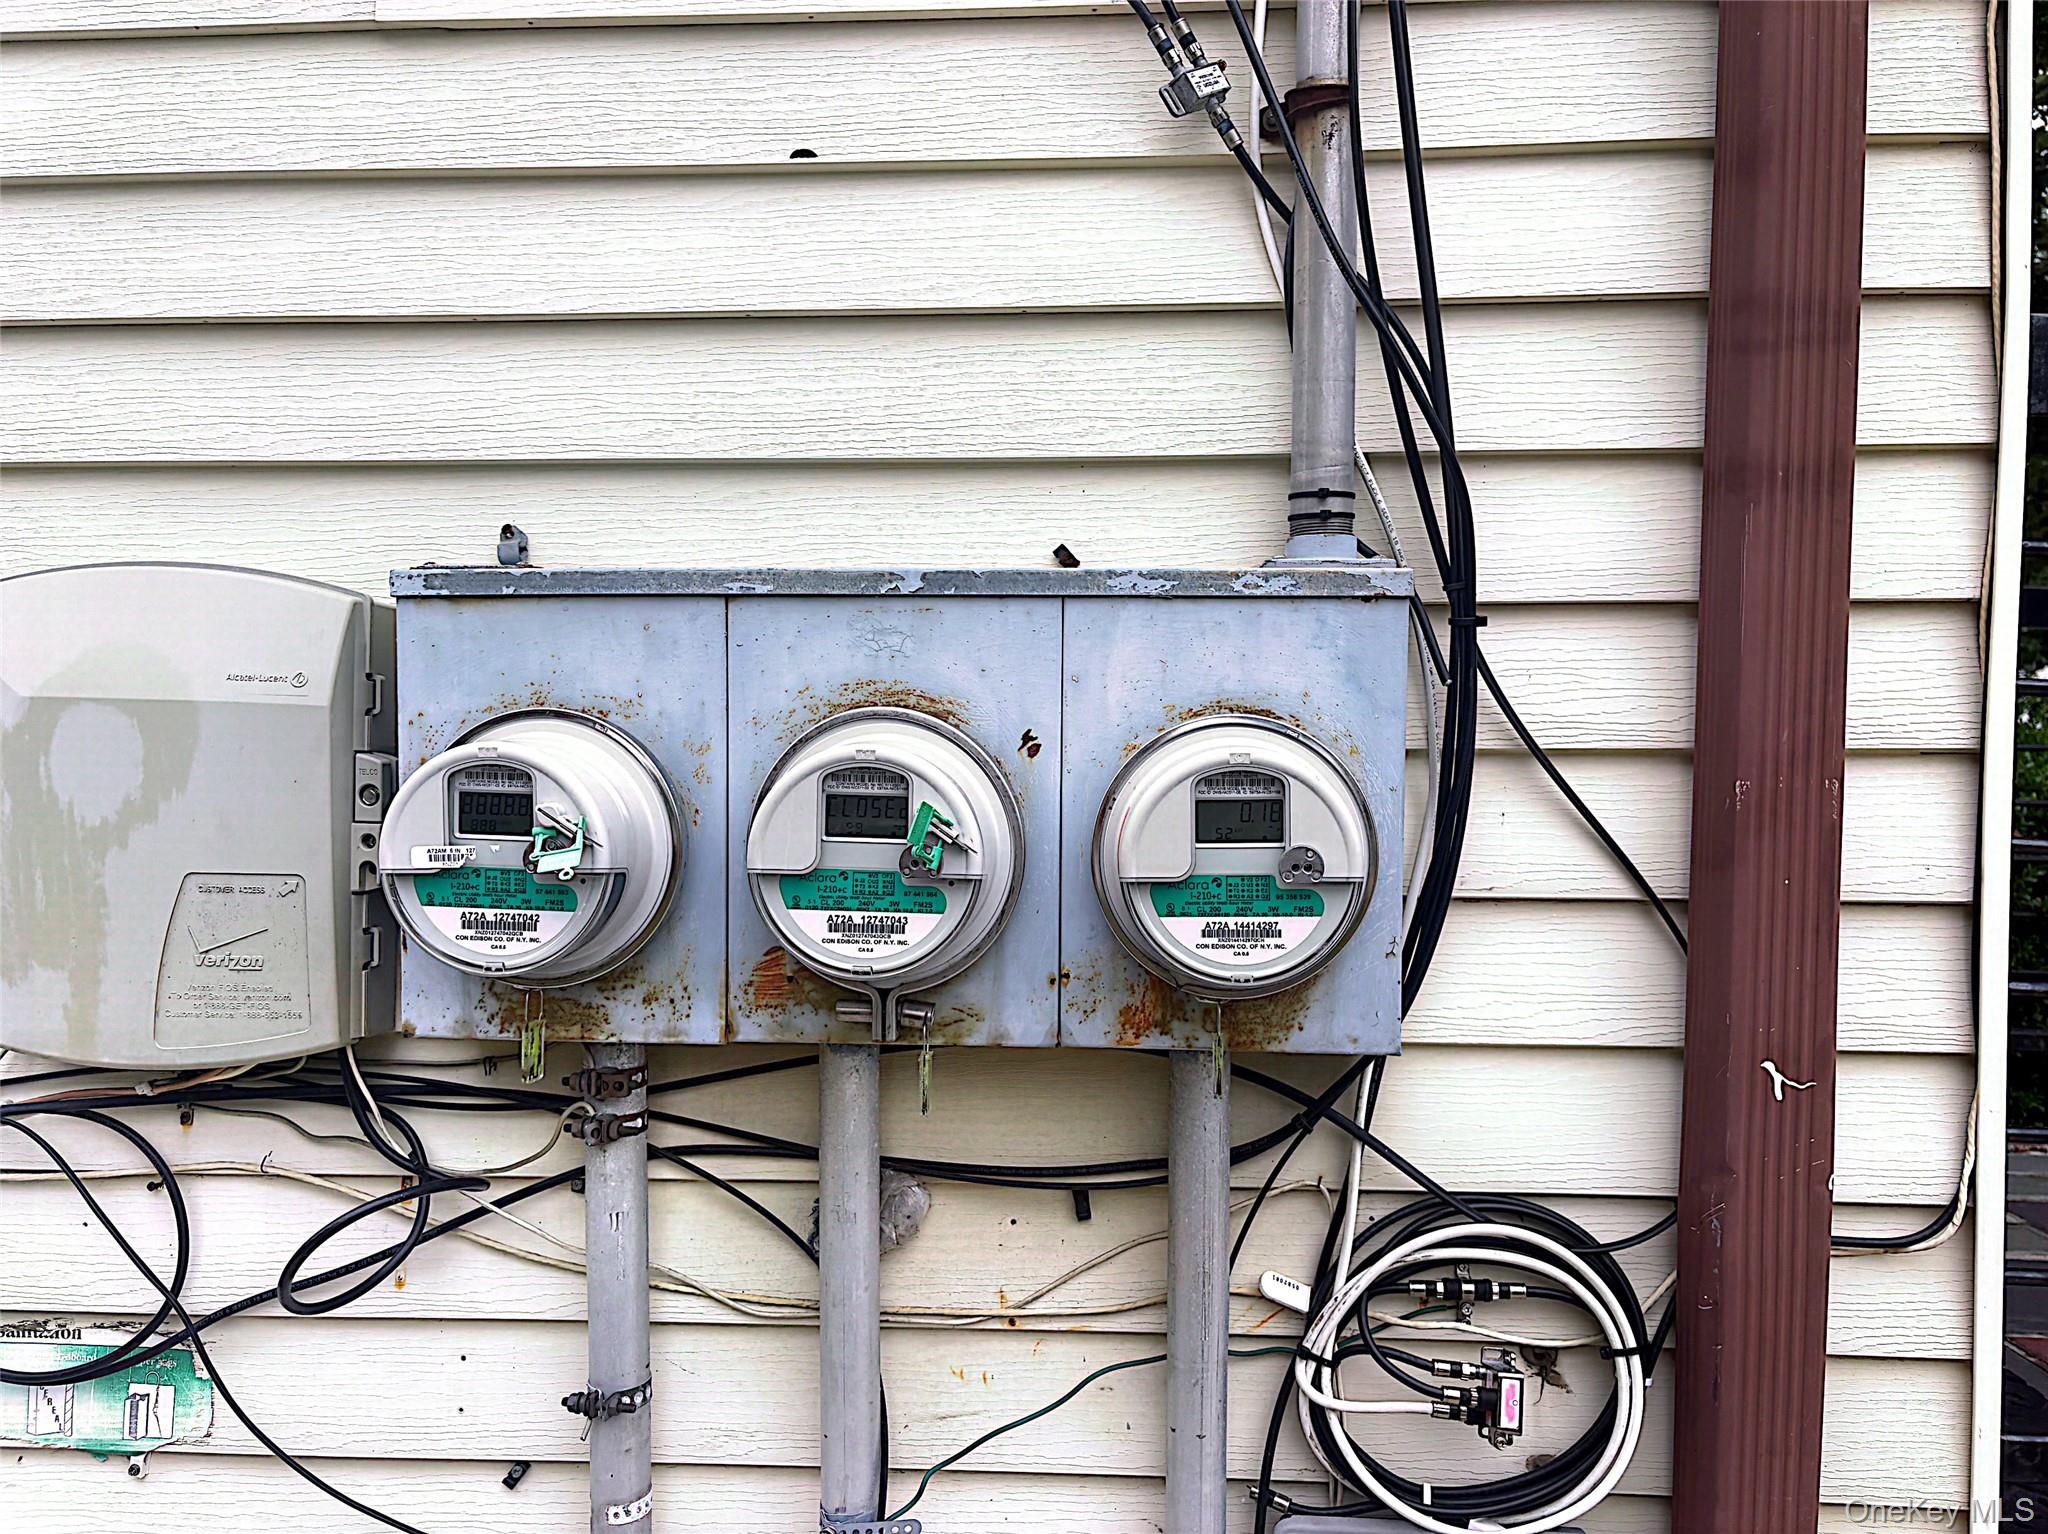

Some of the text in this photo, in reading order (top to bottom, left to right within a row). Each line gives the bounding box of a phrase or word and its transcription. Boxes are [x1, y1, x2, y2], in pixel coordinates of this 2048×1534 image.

[226, 673, 288, 683] Alcatel-Lucent
[359, 768, 378, 776] TELCO
[198, 884, 265, 894] CUSTOMER ACCESS
[460, 912, 540, 923] A72A 12747042
[826, 915, 908, 925] A72A 12747043
[1205, 922, 1279, 930] A72A 14414297
[193, 952, 264, 969] verizon
